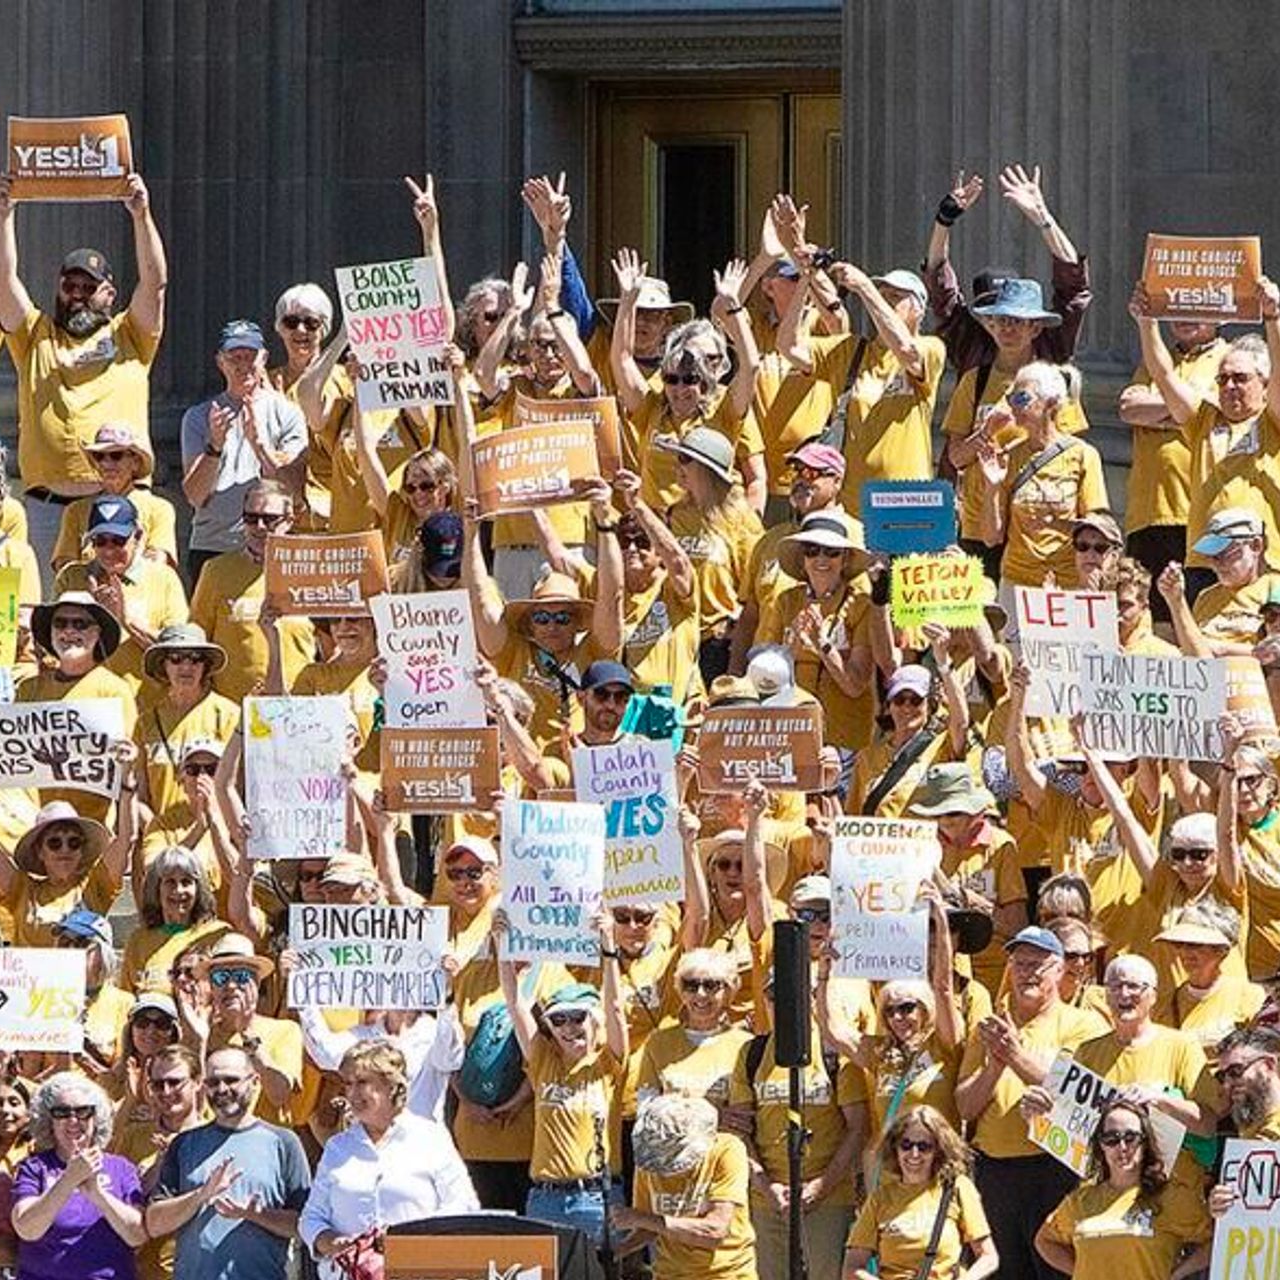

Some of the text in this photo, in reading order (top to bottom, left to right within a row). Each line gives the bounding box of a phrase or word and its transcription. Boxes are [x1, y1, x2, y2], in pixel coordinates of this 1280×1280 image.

[14, 146, 81, 169] YES!
[352, 260, 415, 290] BOISE
[1165, 286, 1208, 306] YES!
[350, 312, 403, 345] SAYS
[359, 360, 420, 381] OPEN
[901, 562, 968, 585] TETON
[288, 587, 332, 602] YES!
[902, 586, 973, 604] VALLEY
[390, 602, 465, 629] Blaine
[1022, 590, 1106, 629] LET
[386, 629, 460, 656] County
[405, 667, 456, 695] YES
[1083, 654, 1208, 692] TWIN FALLS
[1131, 693, 1198, 718] YES TO
[34, 751, 116, 790] YES!
[721, 760, 765, 777] YES!
[402, 779, 444, 797] YES!
[511, 886, 535, 903] All
[301, 906, 428, 941] BINGHAM
[328, 945, 373, 966] YES!
[292, 973, 348, 1006] OPEN
